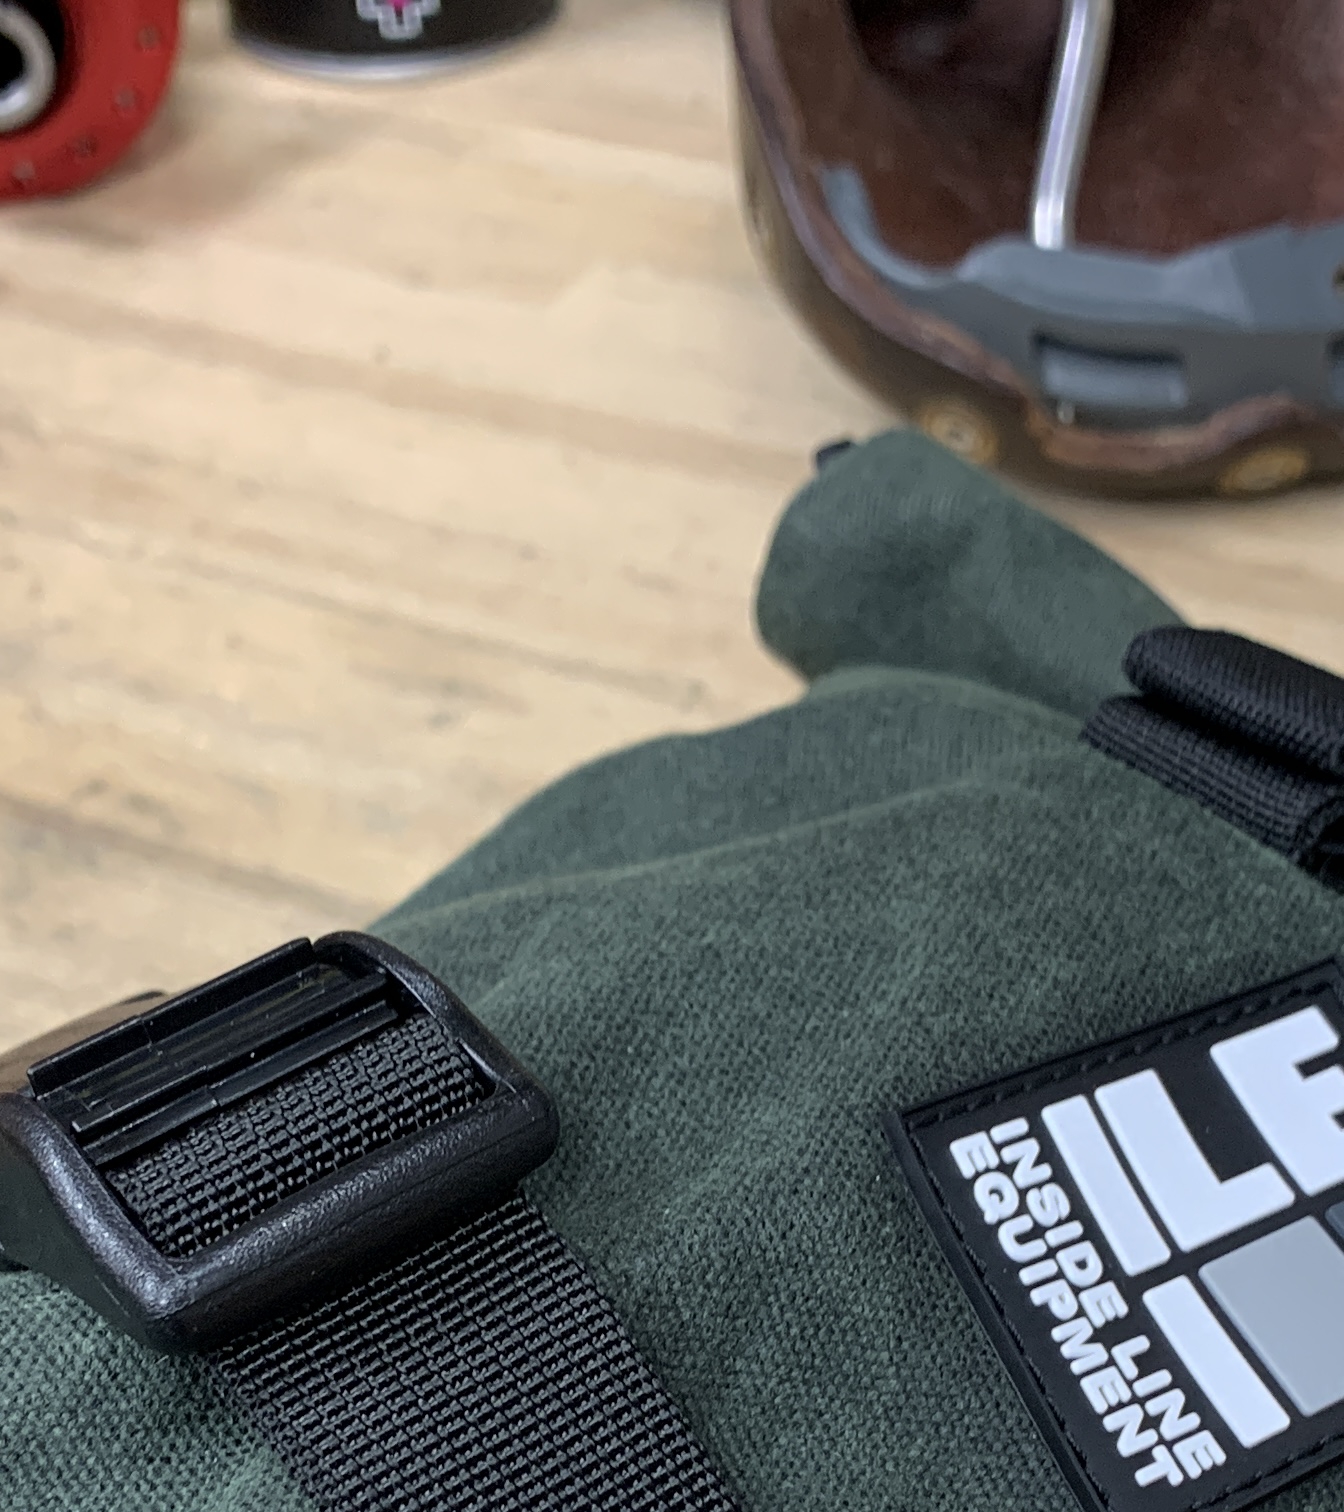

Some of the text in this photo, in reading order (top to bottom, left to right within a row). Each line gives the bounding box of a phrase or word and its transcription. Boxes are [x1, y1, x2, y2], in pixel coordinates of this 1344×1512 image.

[949, 1131, 1184, 1488] EQUIPMENT
[990, 1117, 1226, 1479] INSIDE LINE
